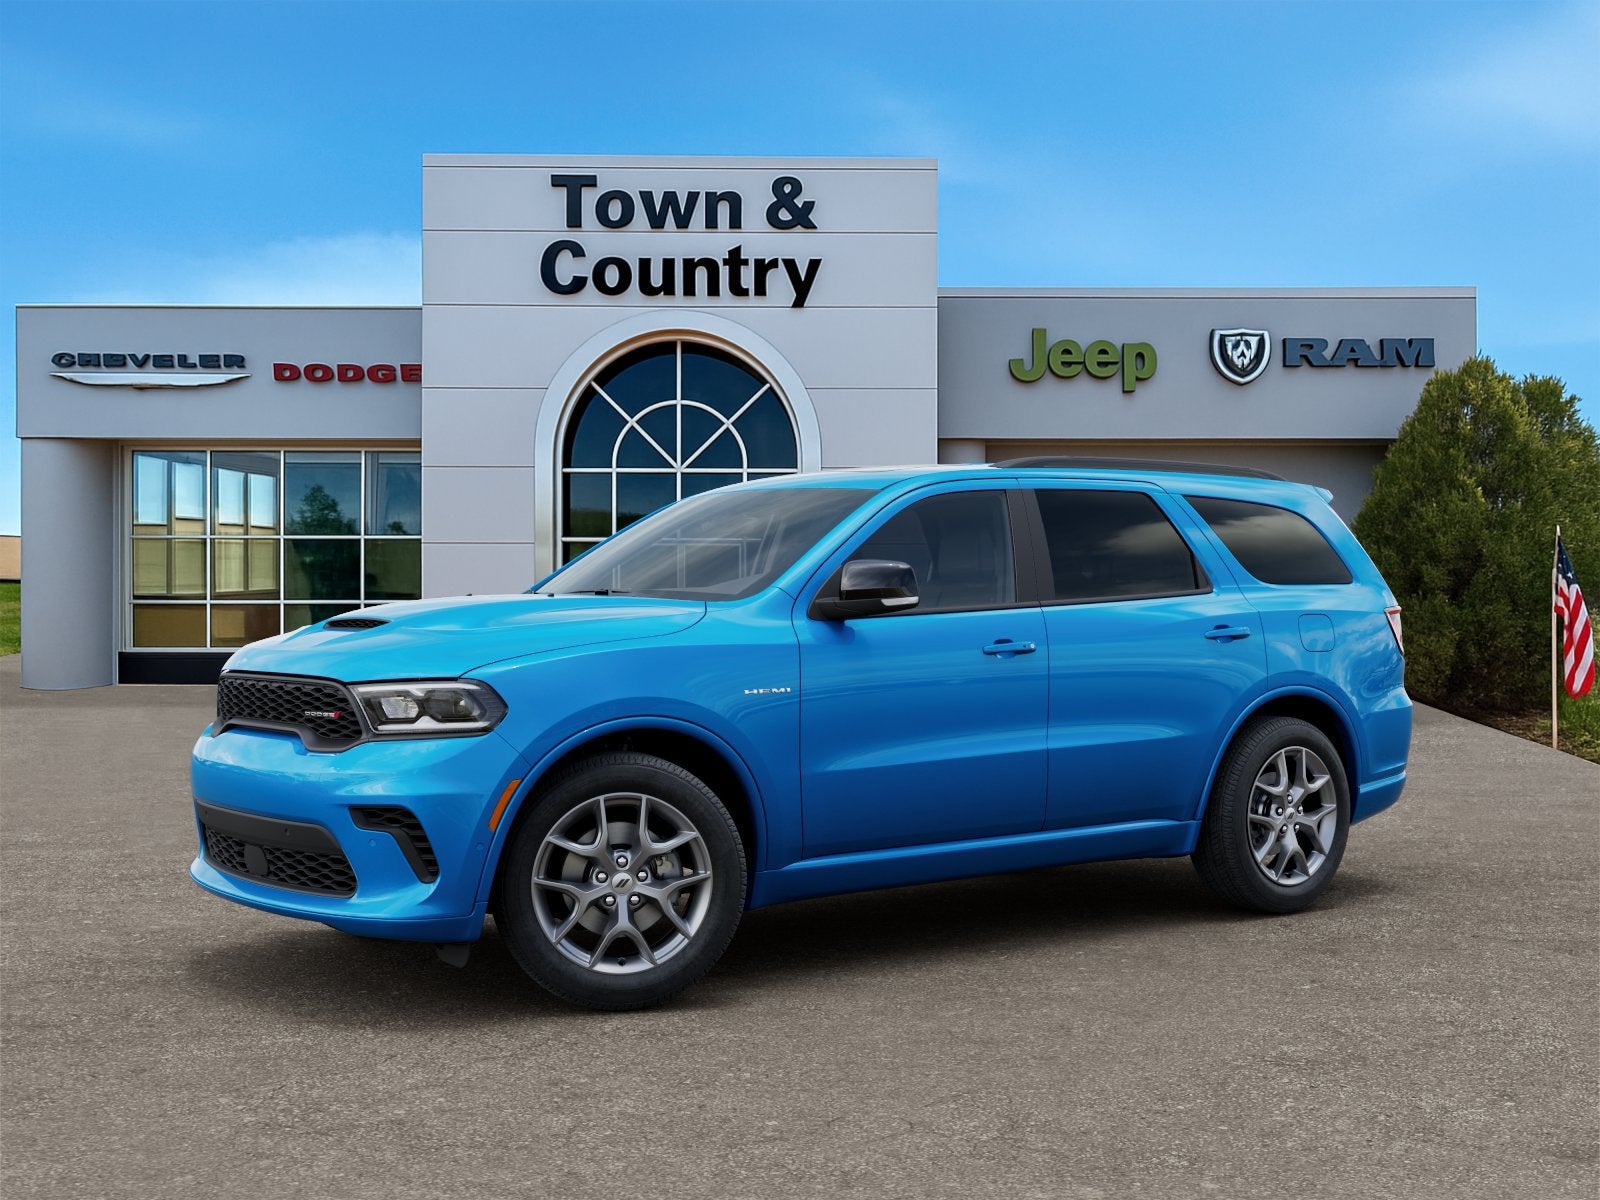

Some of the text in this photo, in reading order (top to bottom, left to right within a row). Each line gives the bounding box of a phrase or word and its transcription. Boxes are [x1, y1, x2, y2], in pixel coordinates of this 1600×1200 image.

[550, 174, 818, 230] Town &
[540, 239, 822, 308] Country
[273, 362, 422, 383] DODGE
[1009, 328, 1157, 392] Jeep
[1282, 338, 1435, 368] RAM
[743, 687, 791, 695] HEMI
